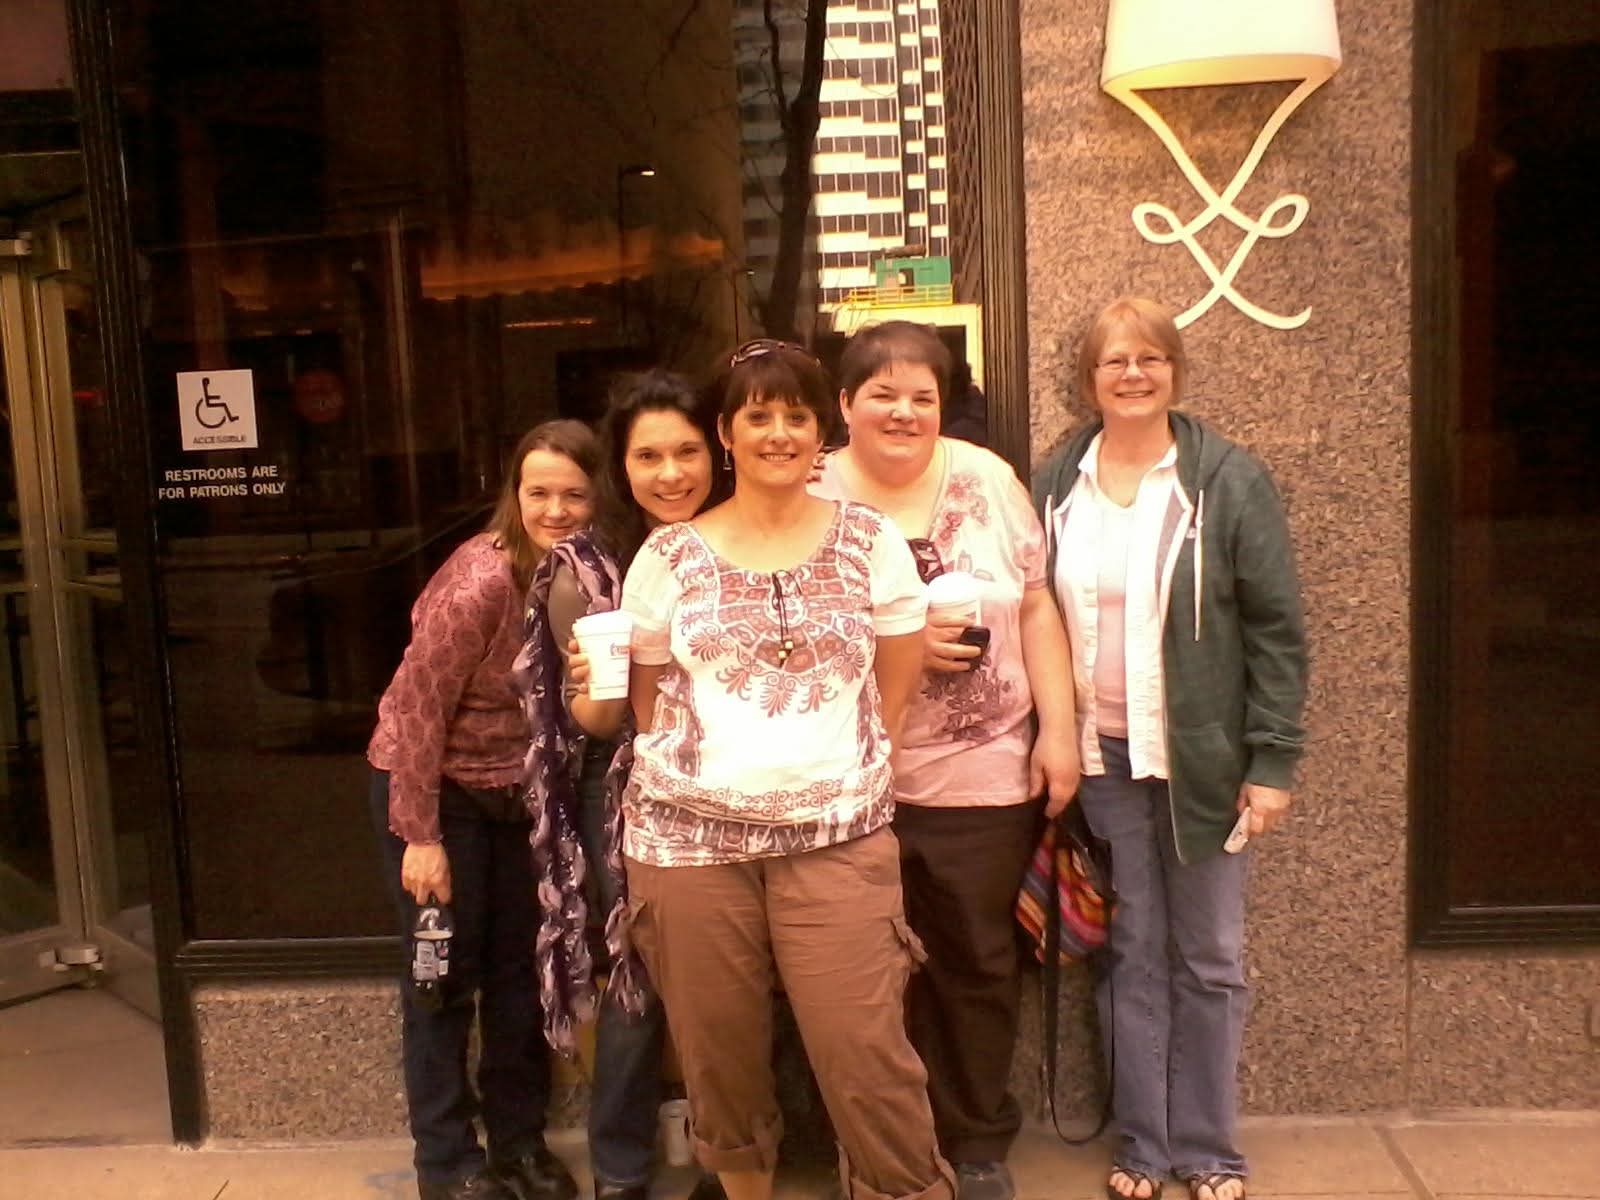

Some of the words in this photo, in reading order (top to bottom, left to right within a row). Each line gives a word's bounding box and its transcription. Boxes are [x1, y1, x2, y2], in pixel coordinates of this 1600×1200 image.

[165, 467, 247, 481] RESTROOMS
[252, 465, 278, 478] ARE
[158, 486, 185, 499] FOR
[190, 484, 248, 498] PATRONS
[253, 481, 286, 495] ONLY
